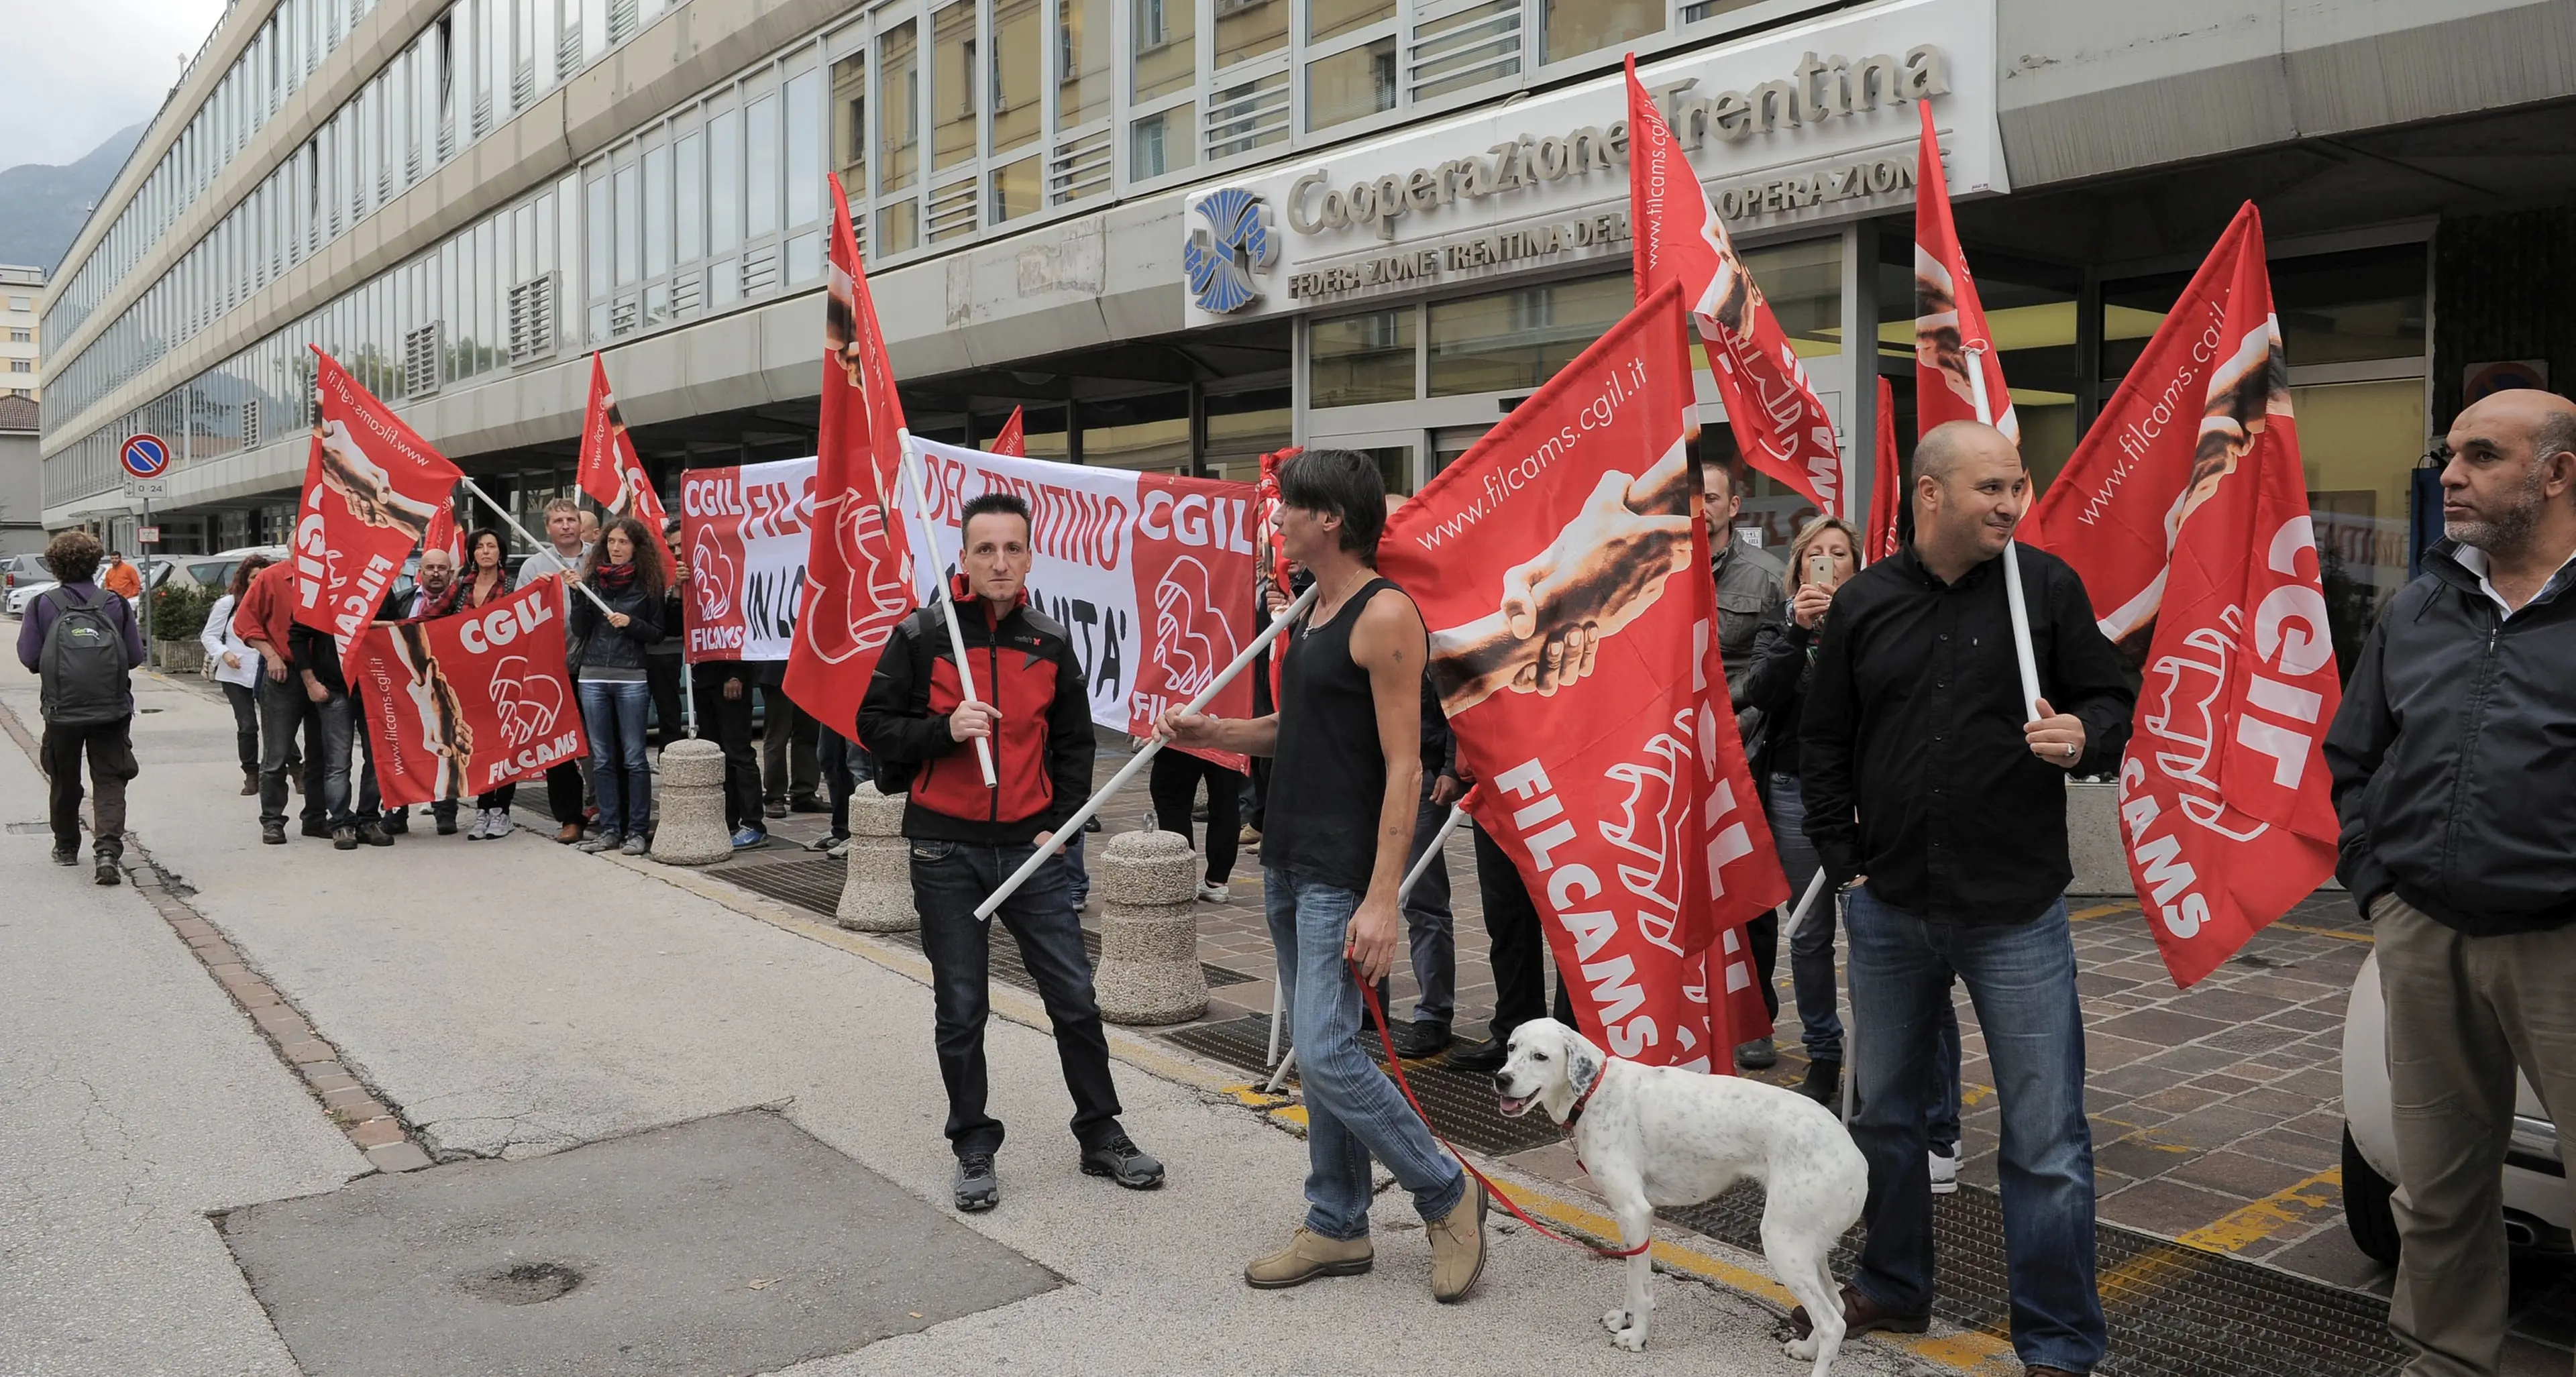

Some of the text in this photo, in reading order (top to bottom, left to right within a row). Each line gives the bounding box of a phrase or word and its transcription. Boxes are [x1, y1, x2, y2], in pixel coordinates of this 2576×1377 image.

[1287, 44, 1951, 241] Cooperazione Trentina
[1287, 249, 1439, 299] FEDERAZIONE
[1440, 224, 1572, 272] TRENTINA
[1712, 148, 1951, 221] OPERAZION
[684, 478, 744, 518] CGIL
[915, 453, 967, 529] DEL
[976, 467, 1128, 571] TNTINO
[1134, 488, 1253, 556] CGIL
[1415, 356, 1648, 552] www.filcams.cgil.it
[460, 590, 553, 655] CGIL
[747, 571, 772, 641] IN
[370, 657, 405, 777] www.filcams.cgil.it
[488, 730, 578, 785] FILCAMS
[2118, 738, 2212, 940] CAMS
[1493, 757, 1659, 1059] FILCAMS
